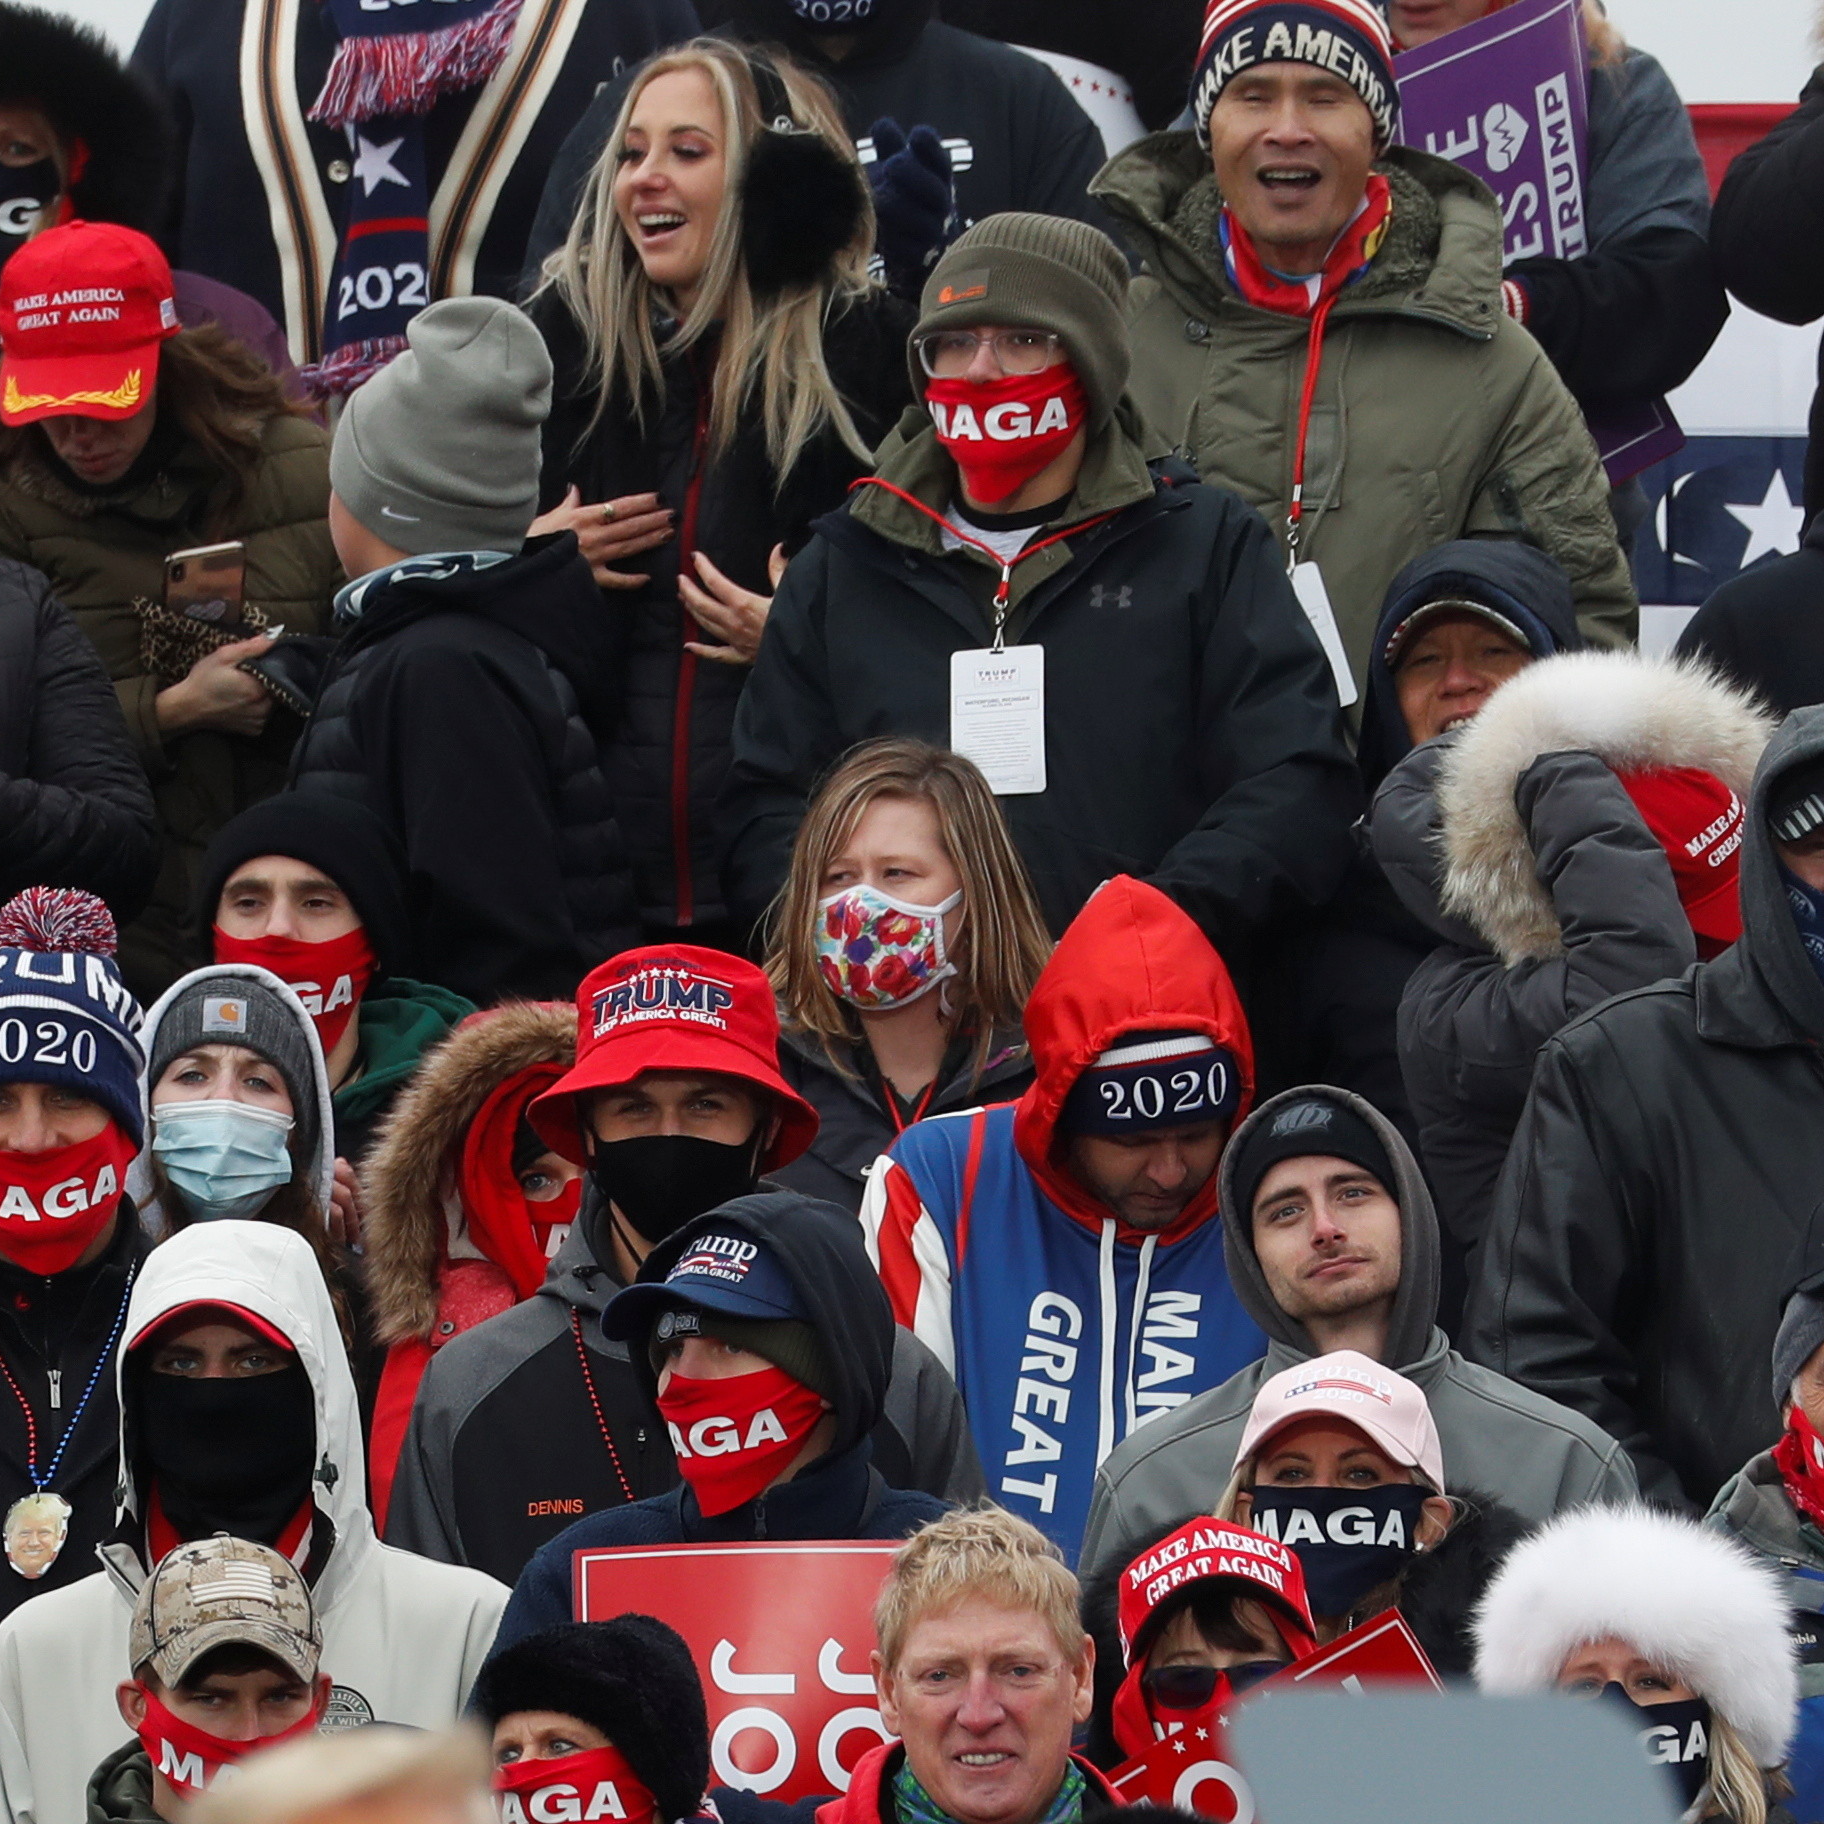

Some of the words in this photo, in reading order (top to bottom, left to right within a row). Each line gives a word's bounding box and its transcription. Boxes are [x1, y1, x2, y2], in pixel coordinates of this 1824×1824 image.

[1197, 25, 1255, 127] MAKE
[1263, 21, 1395, 136] AMERICA
[1541, 78, 1588, 260] TRUMP
[14, 292, 53, 312] MAKE
[54, 287, 124, 307] AMERICA
[18, 309, 64, 330] GREAT
[69, 307, 119, 327] AGAIN
[590, 979, 733, 1021] TRUMP
[594, 1021, 626, 1040] KEEP
[627, 1011, 676, 1030] AMERICA
[679, 1010, 728, 1030] GREAT!
[1101, 1062, 1227, 1119] 2020
[1292, 1365, 1392, 1394] Trump
[1312, 1387, 1366, 1404] 2020
[1002, 1291, 1082, 1512] GREAT
[527, 1498, 583, 1515] DENNIS
[1130, 1545, 1184, 1590] MAKE
[1191, 1527, 1292, 1573] AMERICA
[1145, 1564, 1214, 1607] GREAT
[1217, 1556, 1283, 1590] AGAIN
